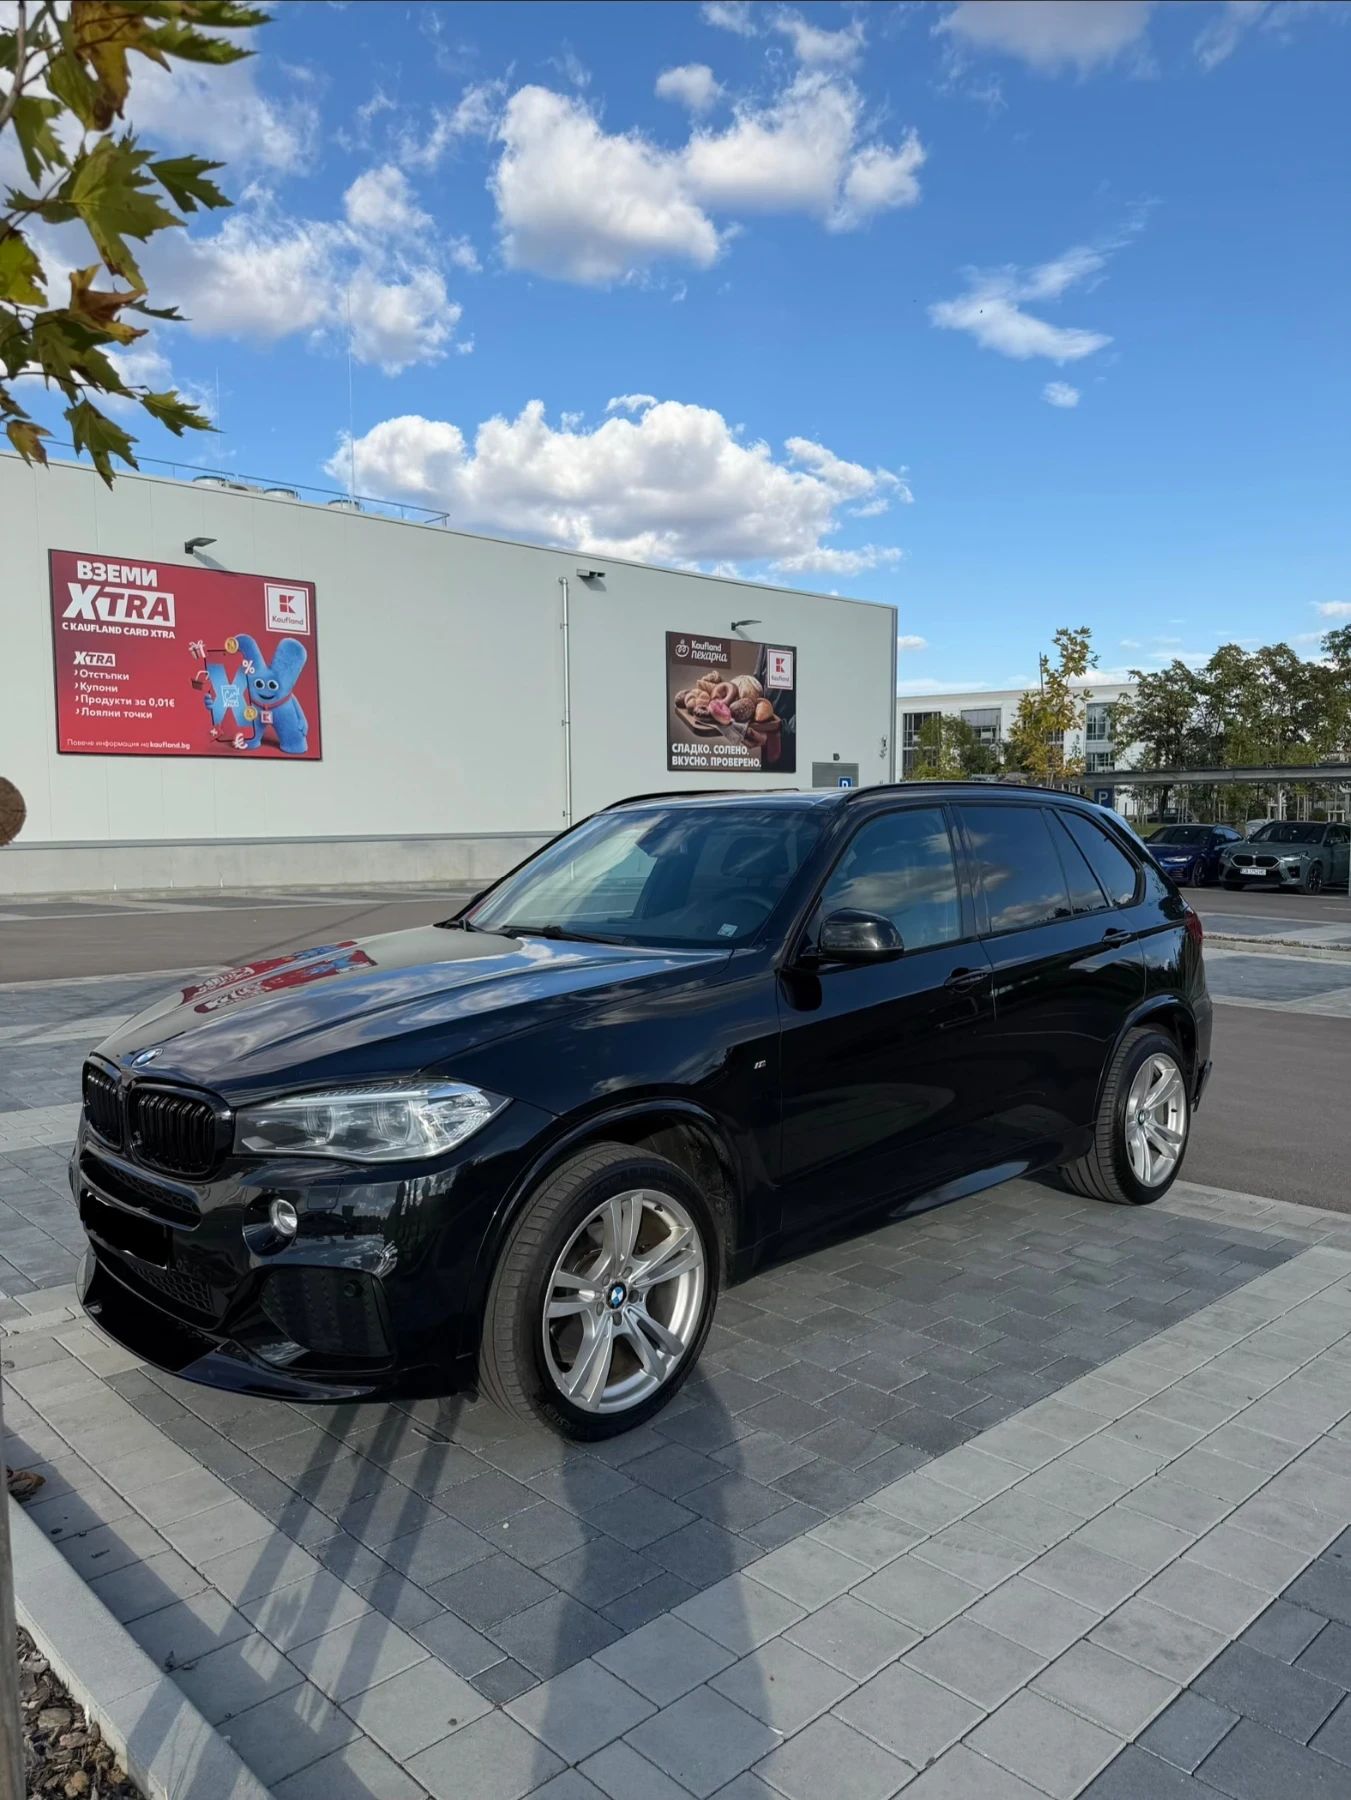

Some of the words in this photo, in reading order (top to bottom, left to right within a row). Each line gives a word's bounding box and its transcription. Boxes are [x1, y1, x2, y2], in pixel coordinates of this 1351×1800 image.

[77, 560, 158, 587] ВЗЕМИ
[62, 582, 176, 627] XTRA
[272, 615, 304, 625] Kaufland
[70, 623, 122, 635] KAUFLAND
[123, 627, 149, 637] CARD
[150, 629, 176, 639] XTRA
[691, 640, 722, 652] Kaufland
[73, 651, 116, 667] XTRA
[691, 650, 728, 663] пекарна
[80, 669, 130, 680] Отстъпки
[80, 682, 118, 693] Купони
[80, 694, 132, 706] Продукти
[149, 698, 175, 707] 0,01€
[81, 707, 121, 717] Лоялни
[123, 710, 153, 719] точки
[67, 738, 94, 747] Повече
[95, 740, 139, 749] информация
[149, 742, 190, 750] kaufland.bg
[671, 743, 712, 755] СЛАДКО.
[713, 745, 749, 755] СОЛЕНО.
[671, 756, 708, 766] ВКУСНО.
[710, 757, 762, 768] ПРОВЕРЕНО.
[1098, 791, 1108, 805] P
